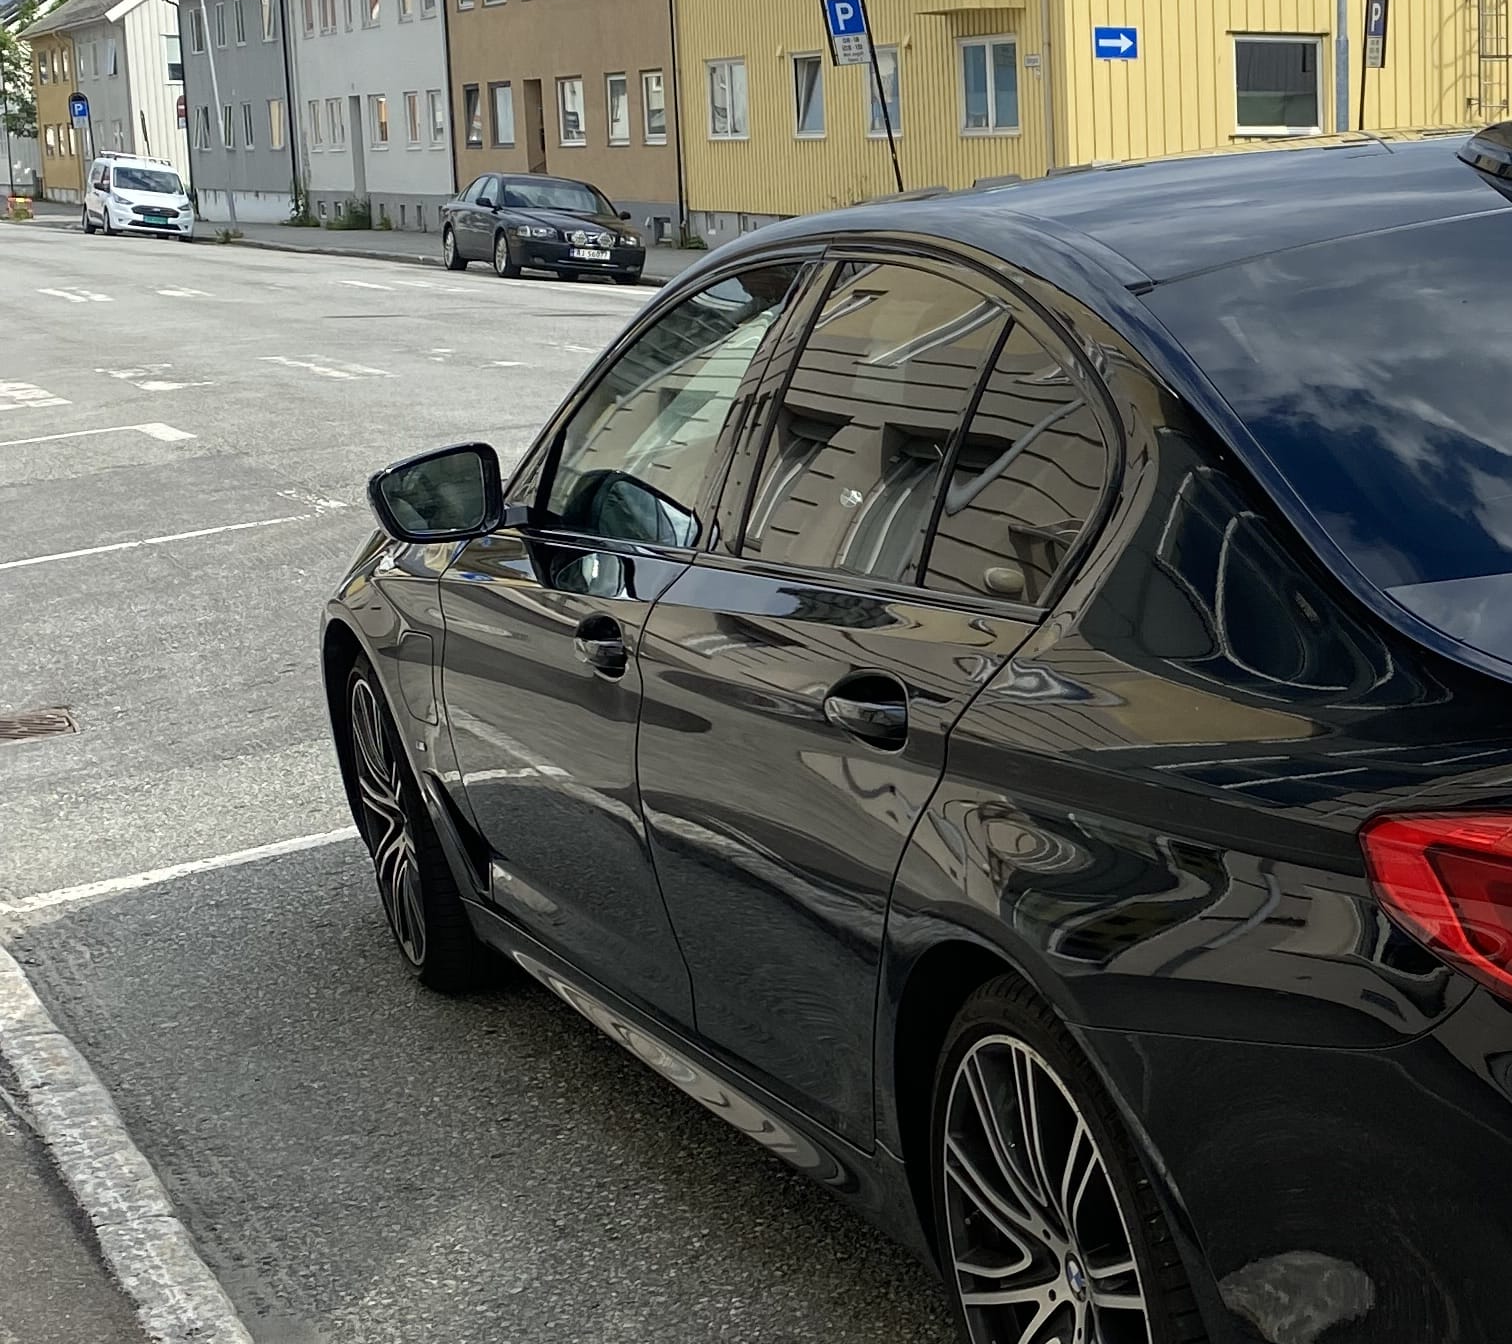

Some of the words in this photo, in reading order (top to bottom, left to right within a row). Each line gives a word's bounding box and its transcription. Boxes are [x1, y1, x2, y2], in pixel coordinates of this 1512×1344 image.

[835, 2, 854, 31] P
[1371, 3, 1381, 32] P
[74, 103, 84, 116] P
